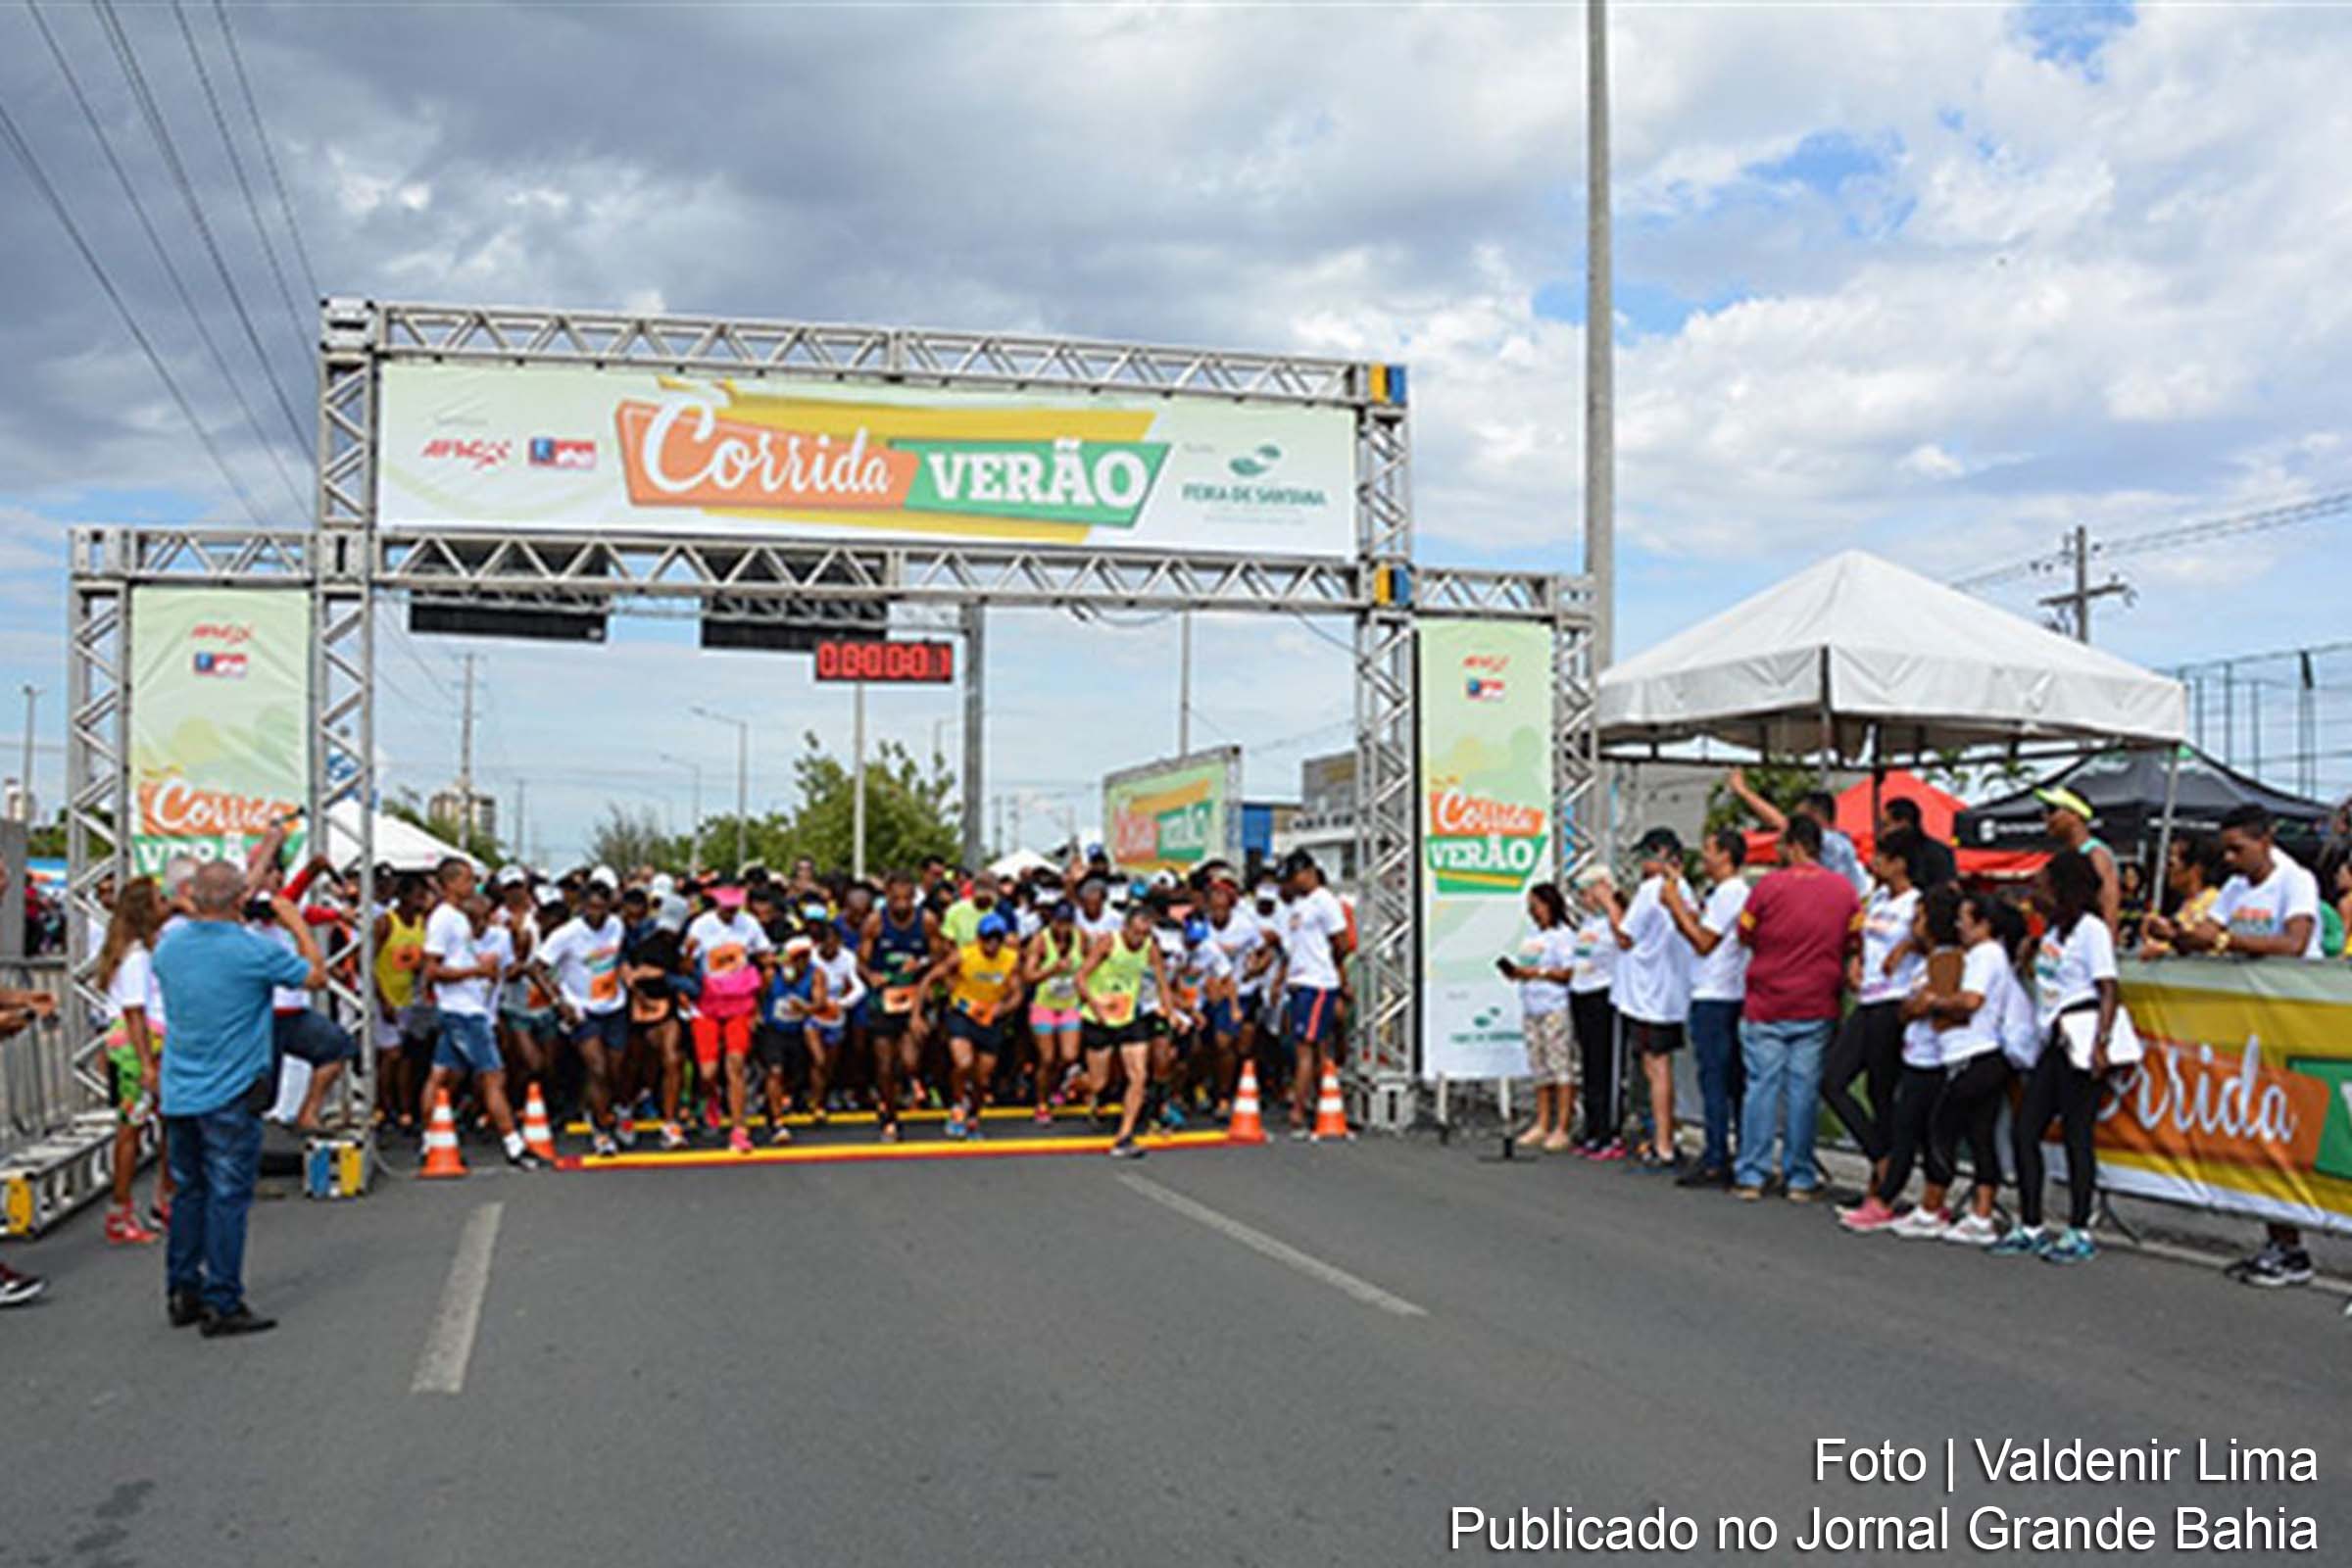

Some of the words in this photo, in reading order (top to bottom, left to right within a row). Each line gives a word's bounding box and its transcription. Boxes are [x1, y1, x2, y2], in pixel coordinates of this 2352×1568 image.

[642, 388, 891, 493] Corrida
[927, 438, 1150, 509] VERÃO
[1430, 832, 1535, 870] VERÃO
